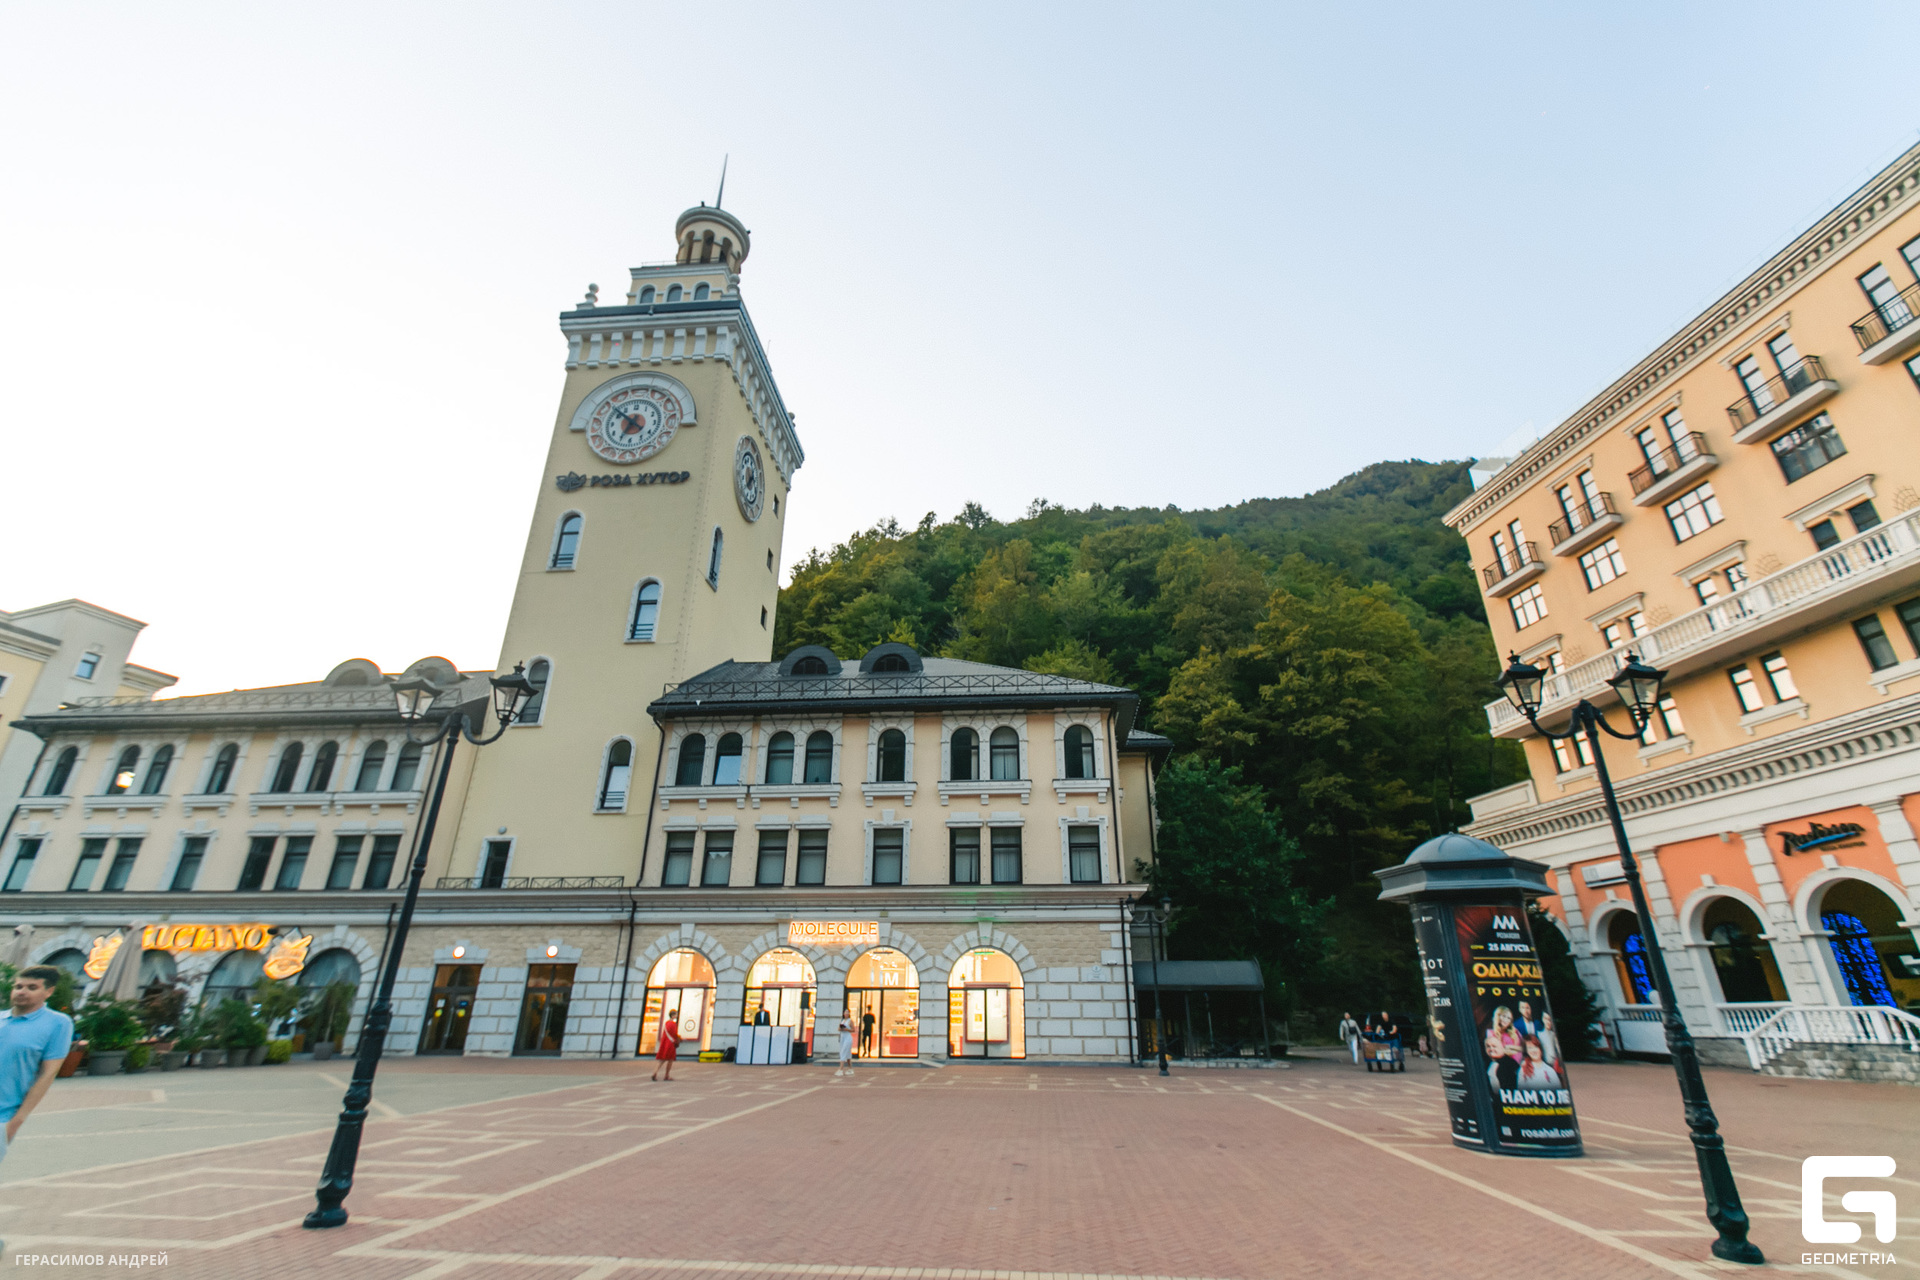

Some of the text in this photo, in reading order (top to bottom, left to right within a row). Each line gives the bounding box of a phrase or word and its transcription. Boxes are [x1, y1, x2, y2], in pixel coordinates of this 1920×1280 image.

[590, 471, 691, 487] РОЗА ХУТОР
[790, 922, 878, 935] MOLECULE
[142, 924, 270, 951] LUCIANO
[1487, 942, 1499, 952] 25
[1500, 943, 1531, 953] АВГУСТА
[884, 972, 899, 986] M
[1499, 1088, 1540, 1105] НАМ
[1539, 1088, 1556, 1105] 10
